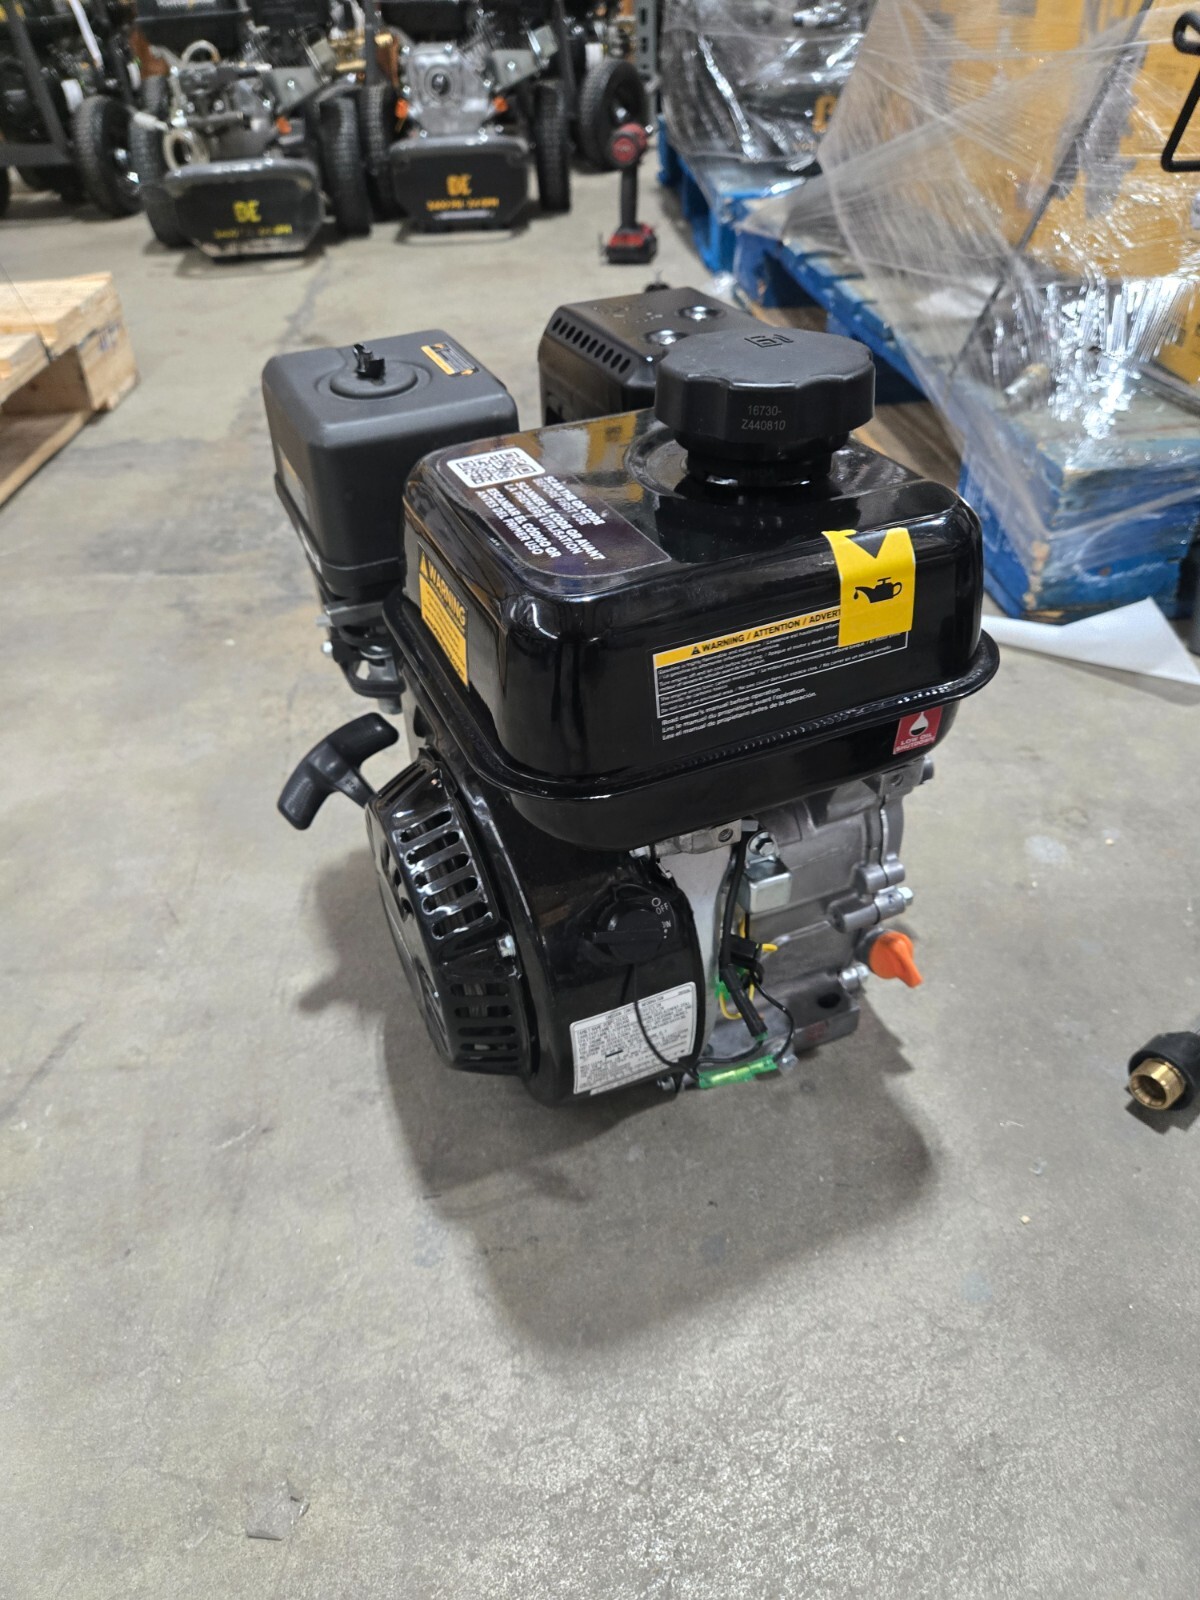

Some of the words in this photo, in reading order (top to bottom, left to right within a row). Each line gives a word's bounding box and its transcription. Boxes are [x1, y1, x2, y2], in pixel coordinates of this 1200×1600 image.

[741, 418, 786, 431] Z440810
[748, 405, 782, 416] 16730-
[532, 478, 561, 499] BEFORE
[554, 498, 579, 514] FIRST
[571, 513, 591, 526] USE
[544, 476, 565, 491] SCAN
[560, 489, 578, 501] THE
[571, 500, 587, 509] QR
[581, 508, 606, 526] CODE
[475, 491, 499, 508] ANTES
[492, 507, 509, 520] DEL
[502, 519, 531, 541] PRIMER
[524, 540, 544, 555] USO
[486, 488, 521, 517] ESCANEAR
[513, 515, 528, 524] EL
[545, 546, 562, 558] QR
[504, 484, 518, 493] LA
[539, 517, 583, 554] UTILISATION
[515, 482, 547, 506] SCANNER
[541, 505, 555, 514] LE
[549, 513, 573, 530] CODE
[566, 529, 583, 539] QR
[575, 539, 606, 560] AVANT
[753, 620, 800, 639] ATTENTION
[895, 736, 936, 752] SHUTDOWN
[900, 737, 919, 746] LOW
[655, 902, 669, 915] OFF
